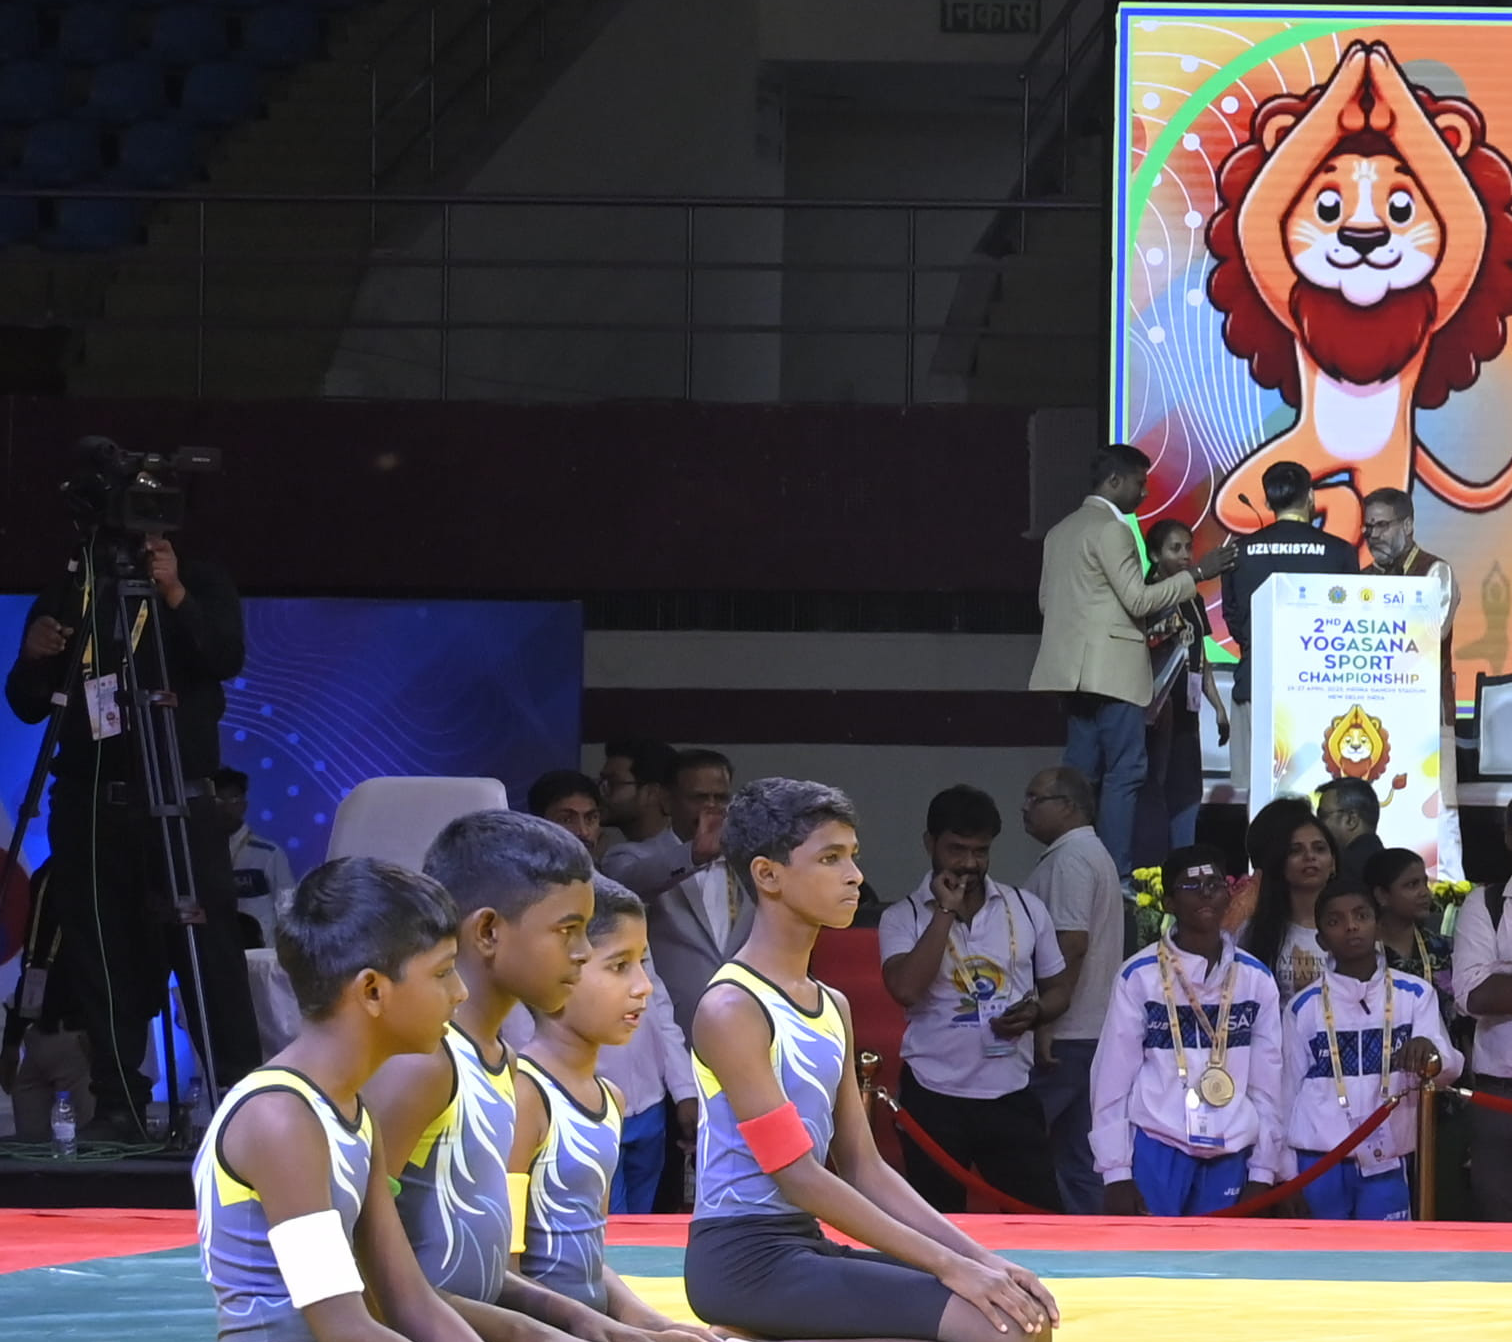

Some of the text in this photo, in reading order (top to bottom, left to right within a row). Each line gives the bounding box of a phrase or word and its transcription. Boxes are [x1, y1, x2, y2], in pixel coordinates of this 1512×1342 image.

[1383, 592, 1404, 604] SAI
[1342, 619, 1407, 635] ASIAN
[1300, 635, 1419, 653] YOGASANA
[1324, 654, 1395, 670] SPORT
[1298, 671, 1419, 685] CHAMPIONSHIP
[1147, 1021, 1169, 1031] JUS
